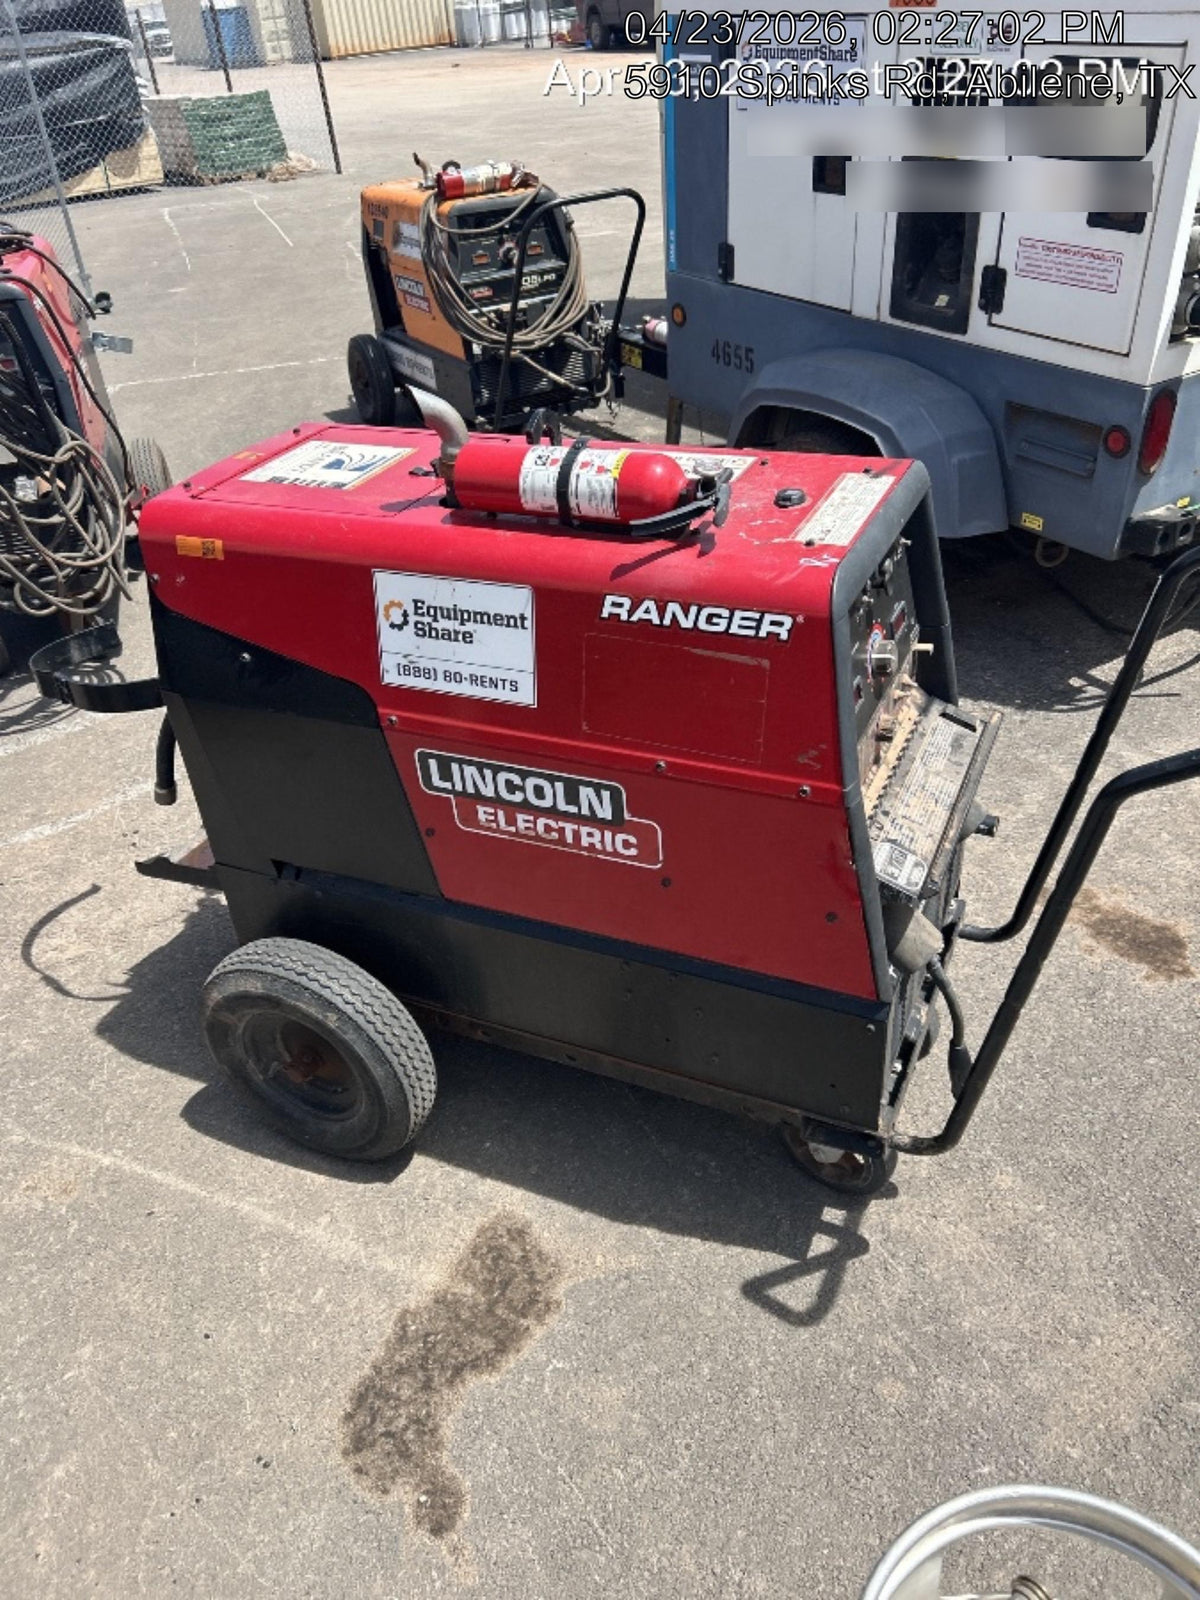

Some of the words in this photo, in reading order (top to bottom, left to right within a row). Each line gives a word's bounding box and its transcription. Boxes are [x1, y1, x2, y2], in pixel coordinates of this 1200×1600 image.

[711, 338, 755, 374] 4655
[412, 599, 528, 630] Equipment
[413, 621, 474, 644] Share
[600, 593, 794, 642] RANGER
[397, 662, 438, 682] (888)
[443, 670, 519, 692] 80-RENTS
[428, 758, 613, 821] LINCOLN
[476, 804, 639, 857] ELECTRIC
